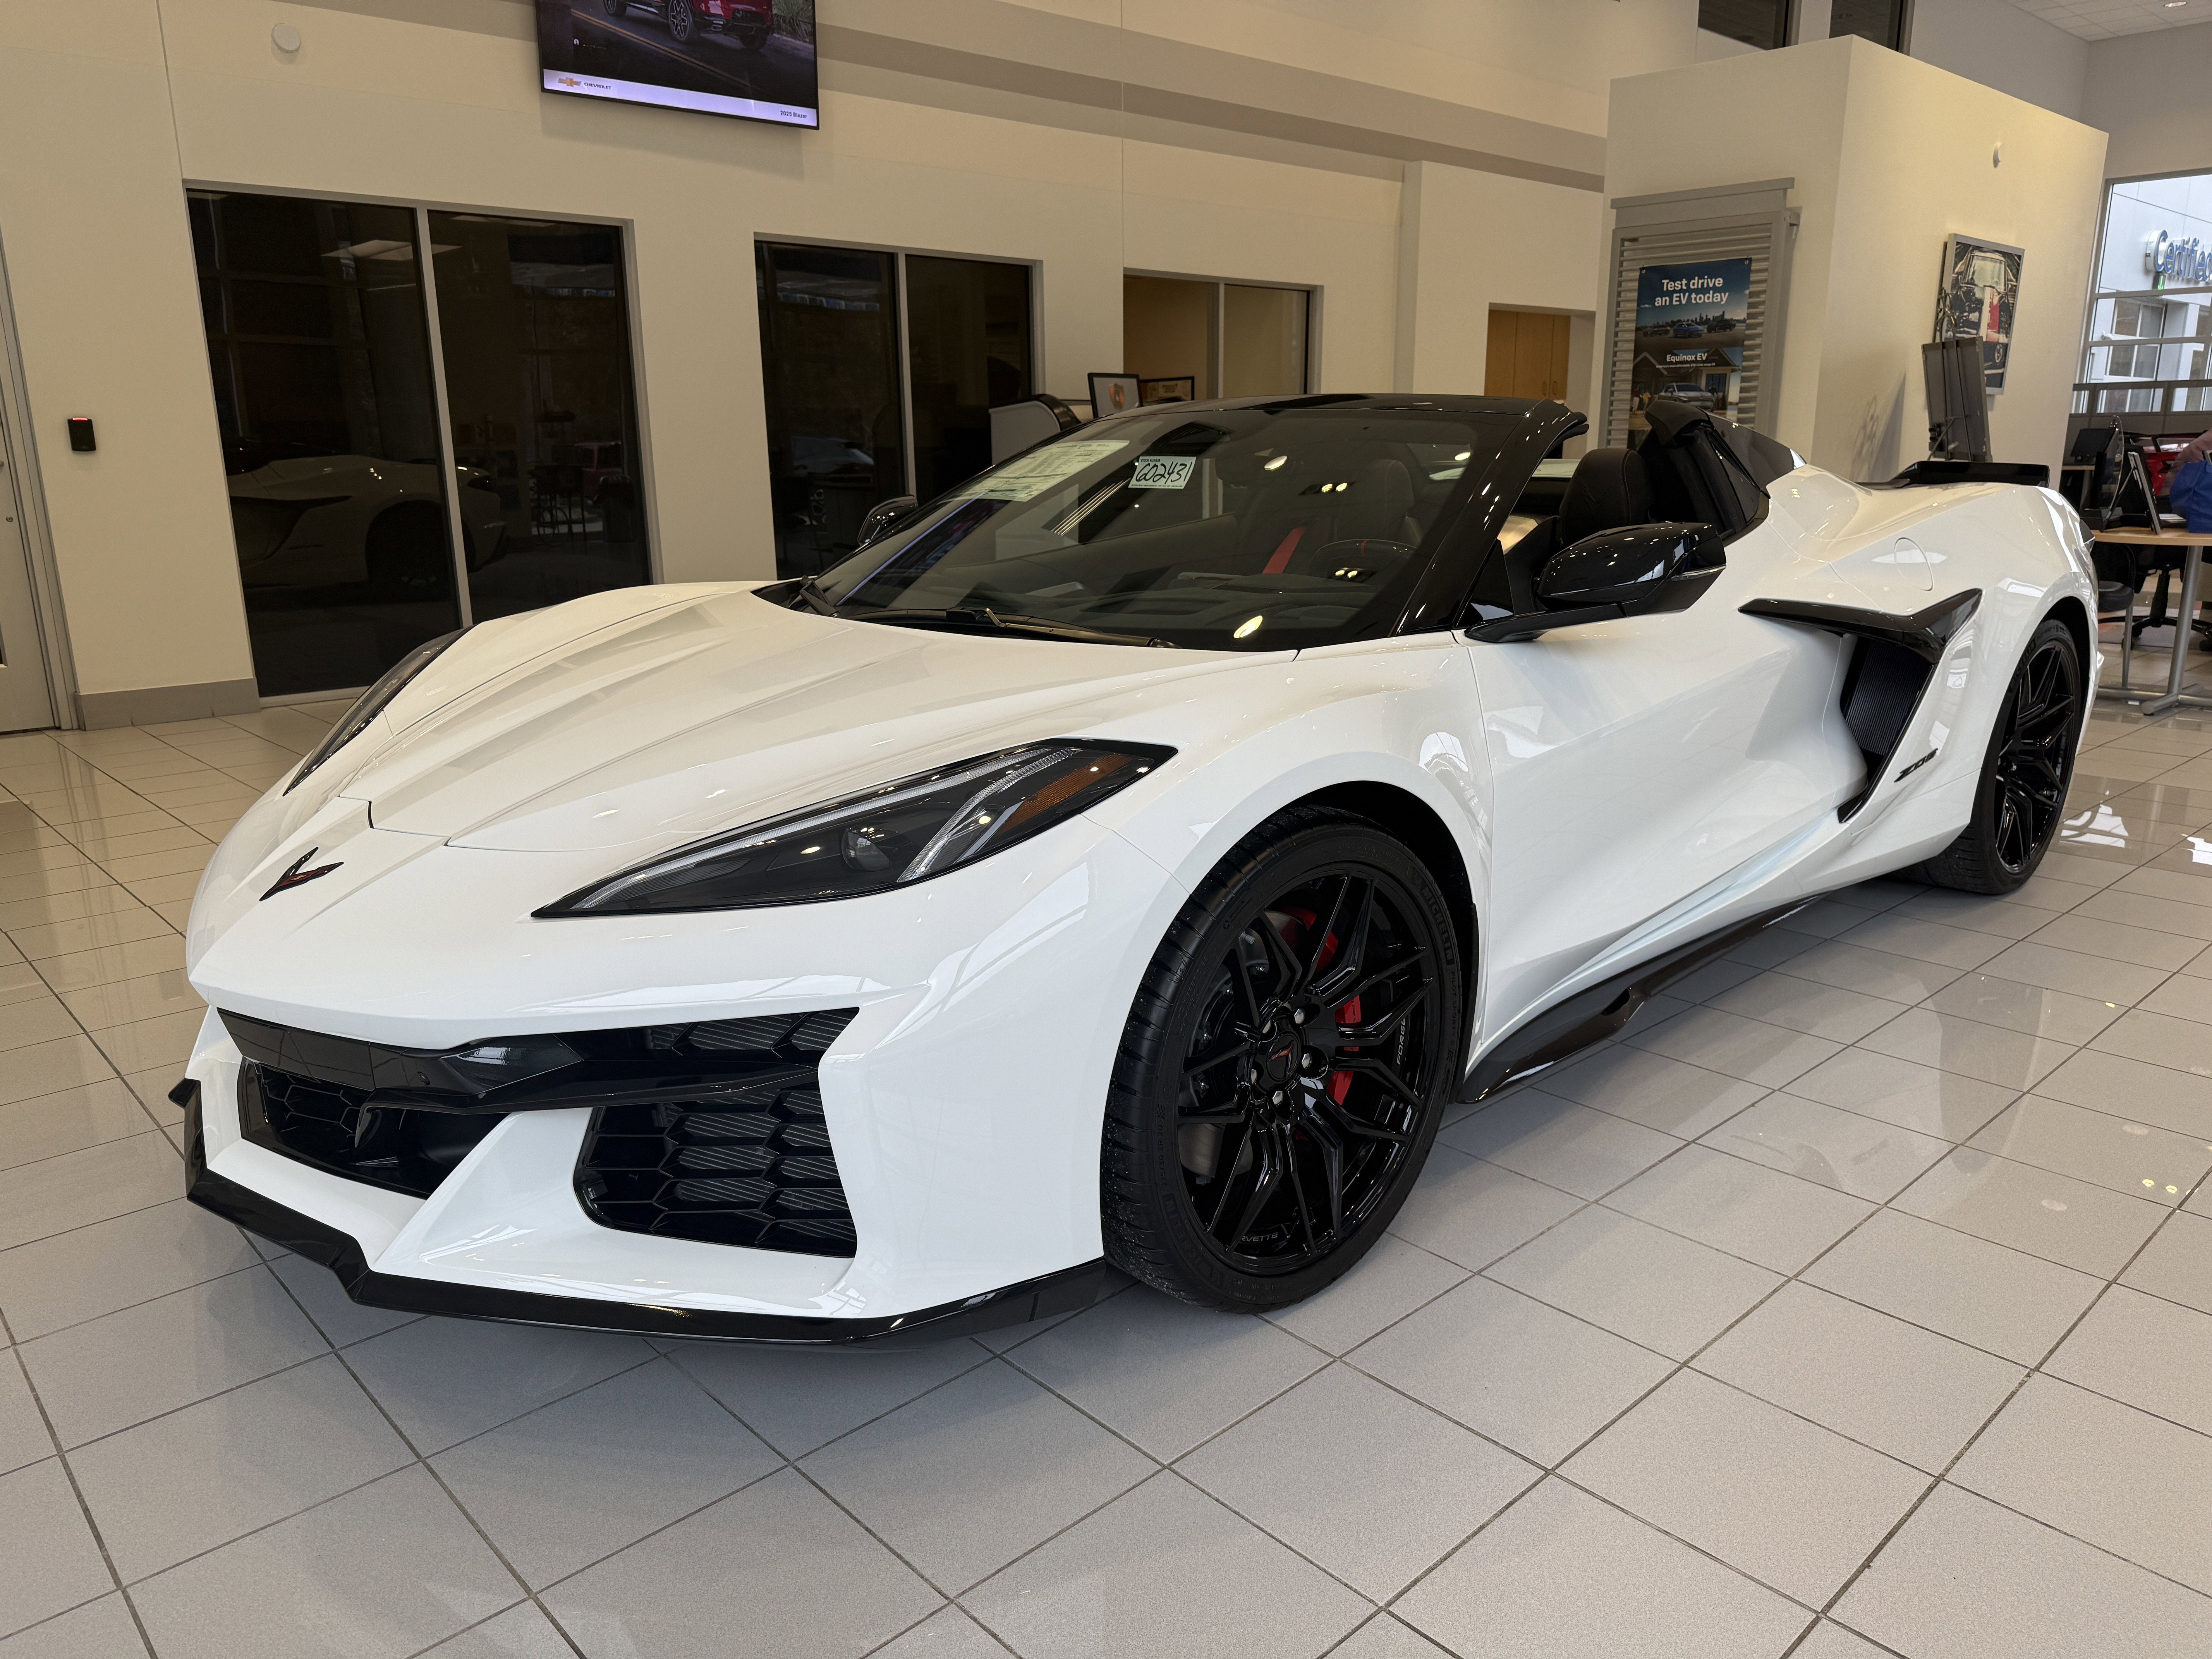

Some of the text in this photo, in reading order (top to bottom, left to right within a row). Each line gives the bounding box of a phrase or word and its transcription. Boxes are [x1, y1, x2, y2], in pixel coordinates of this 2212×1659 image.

[1662, 275, 1723, 291] Test drive
[1654, 290, 1729, 306] an EV today
[1666, 354, 1696, 362] Equinox
[1135, 461, 1192, 484] 602431
[1422, 886, 1453, 960] MICHELIN
[1396, 1017, 1406, 1065] FORGE
[1158, 1125, 1168, 1187] 275/30 ZR 20
